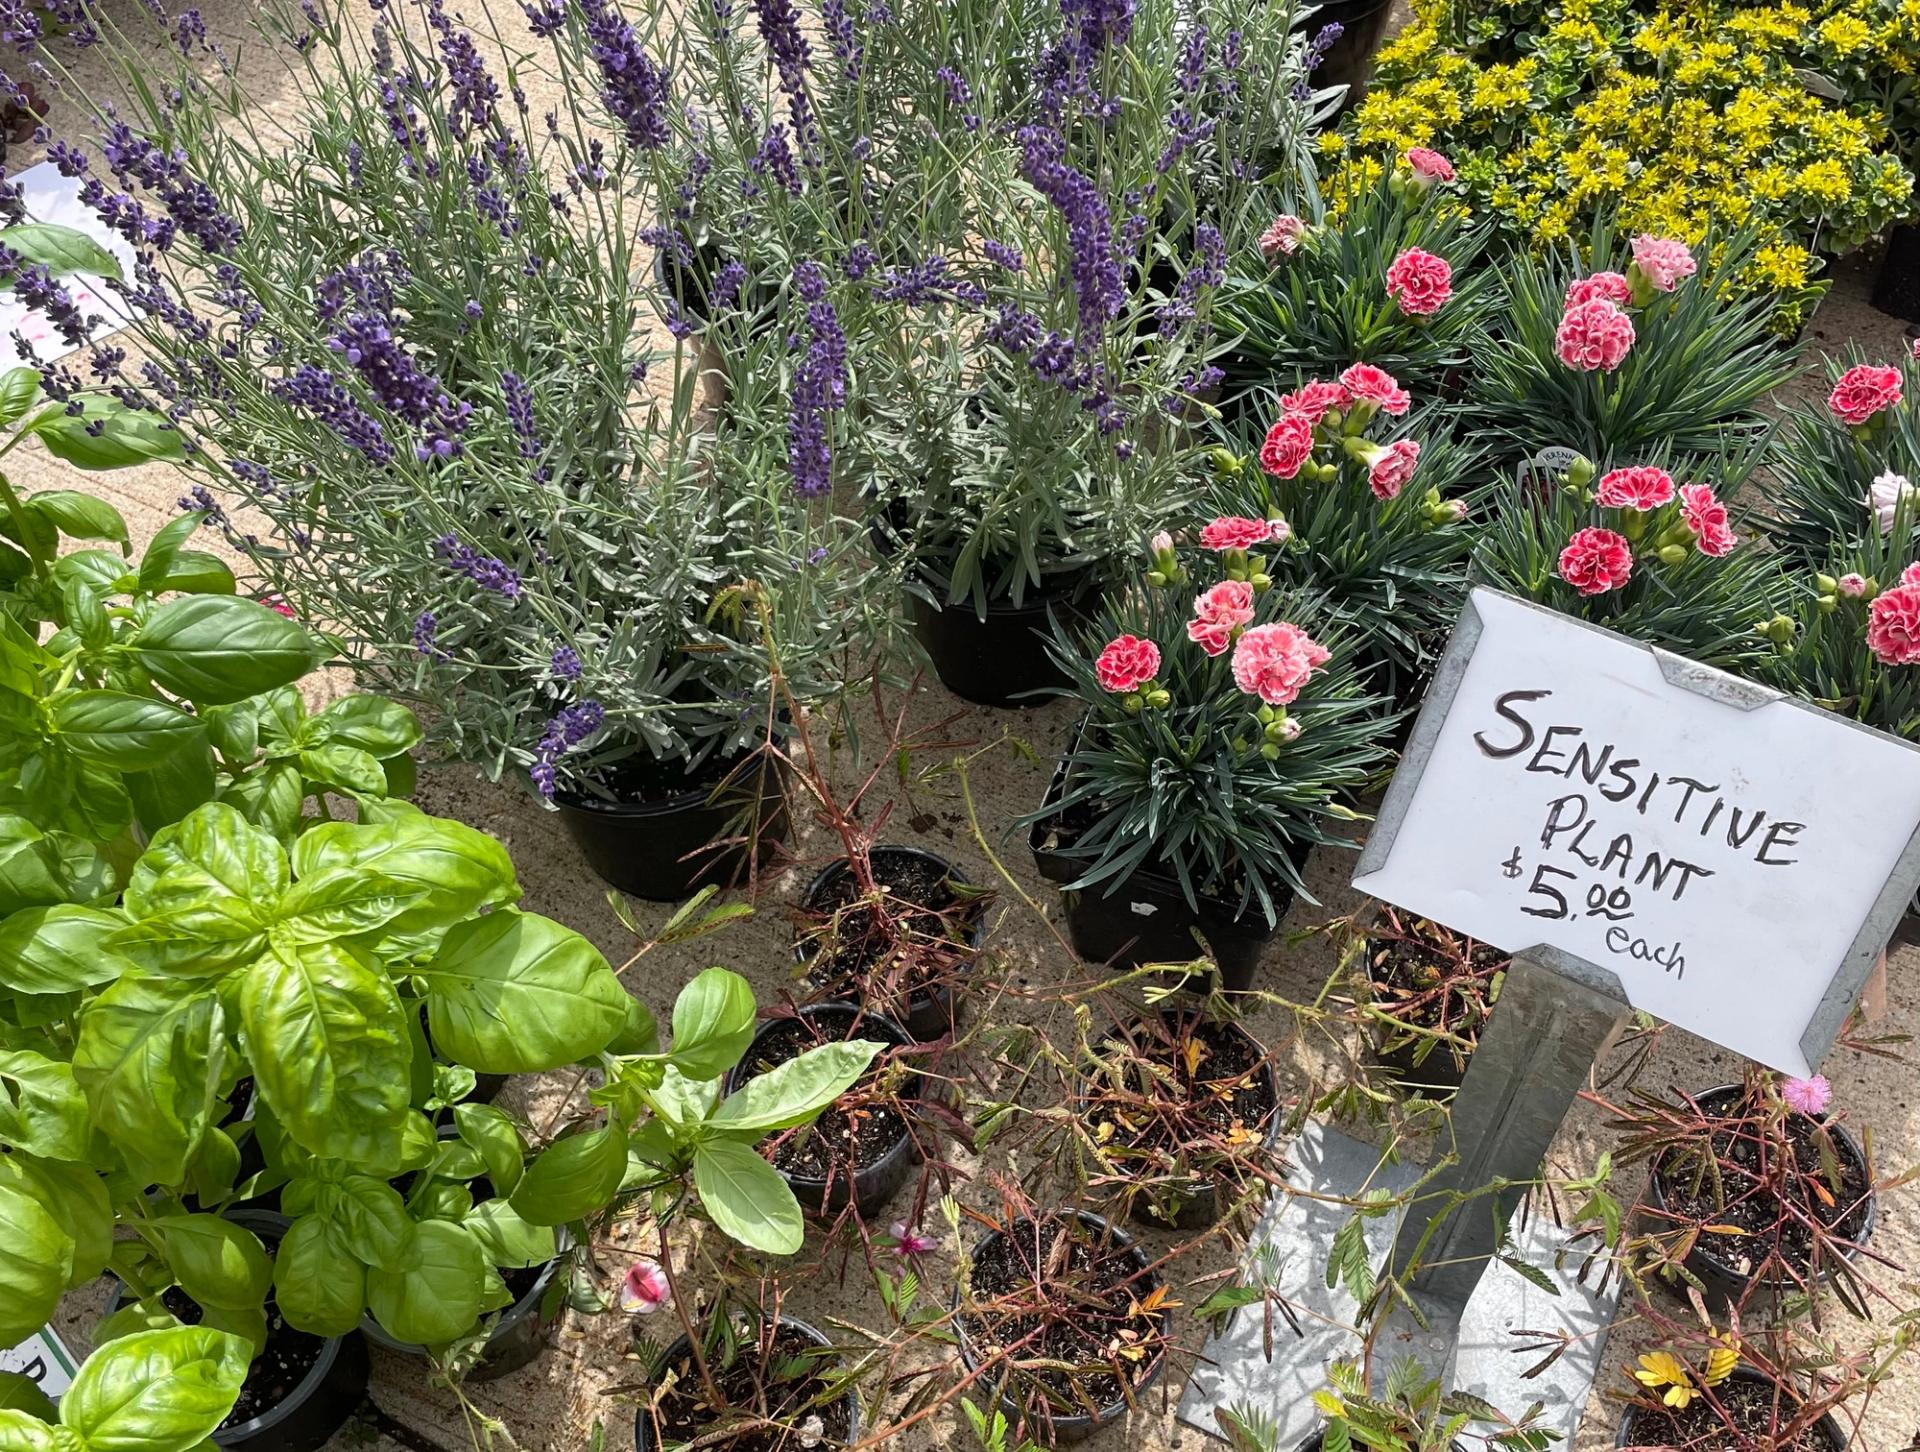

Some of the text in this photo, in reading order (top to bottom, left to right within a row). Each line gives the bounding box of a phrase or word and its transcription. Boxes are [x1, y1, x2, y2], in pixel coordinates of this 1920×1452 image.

[1473, 690, 1807, 865] SENSITIVE
[1502, 846, 1634, 921] $5.00
[1541, 794, 1716, 901] PLANT
[1606, 926, 1685, 980] each
